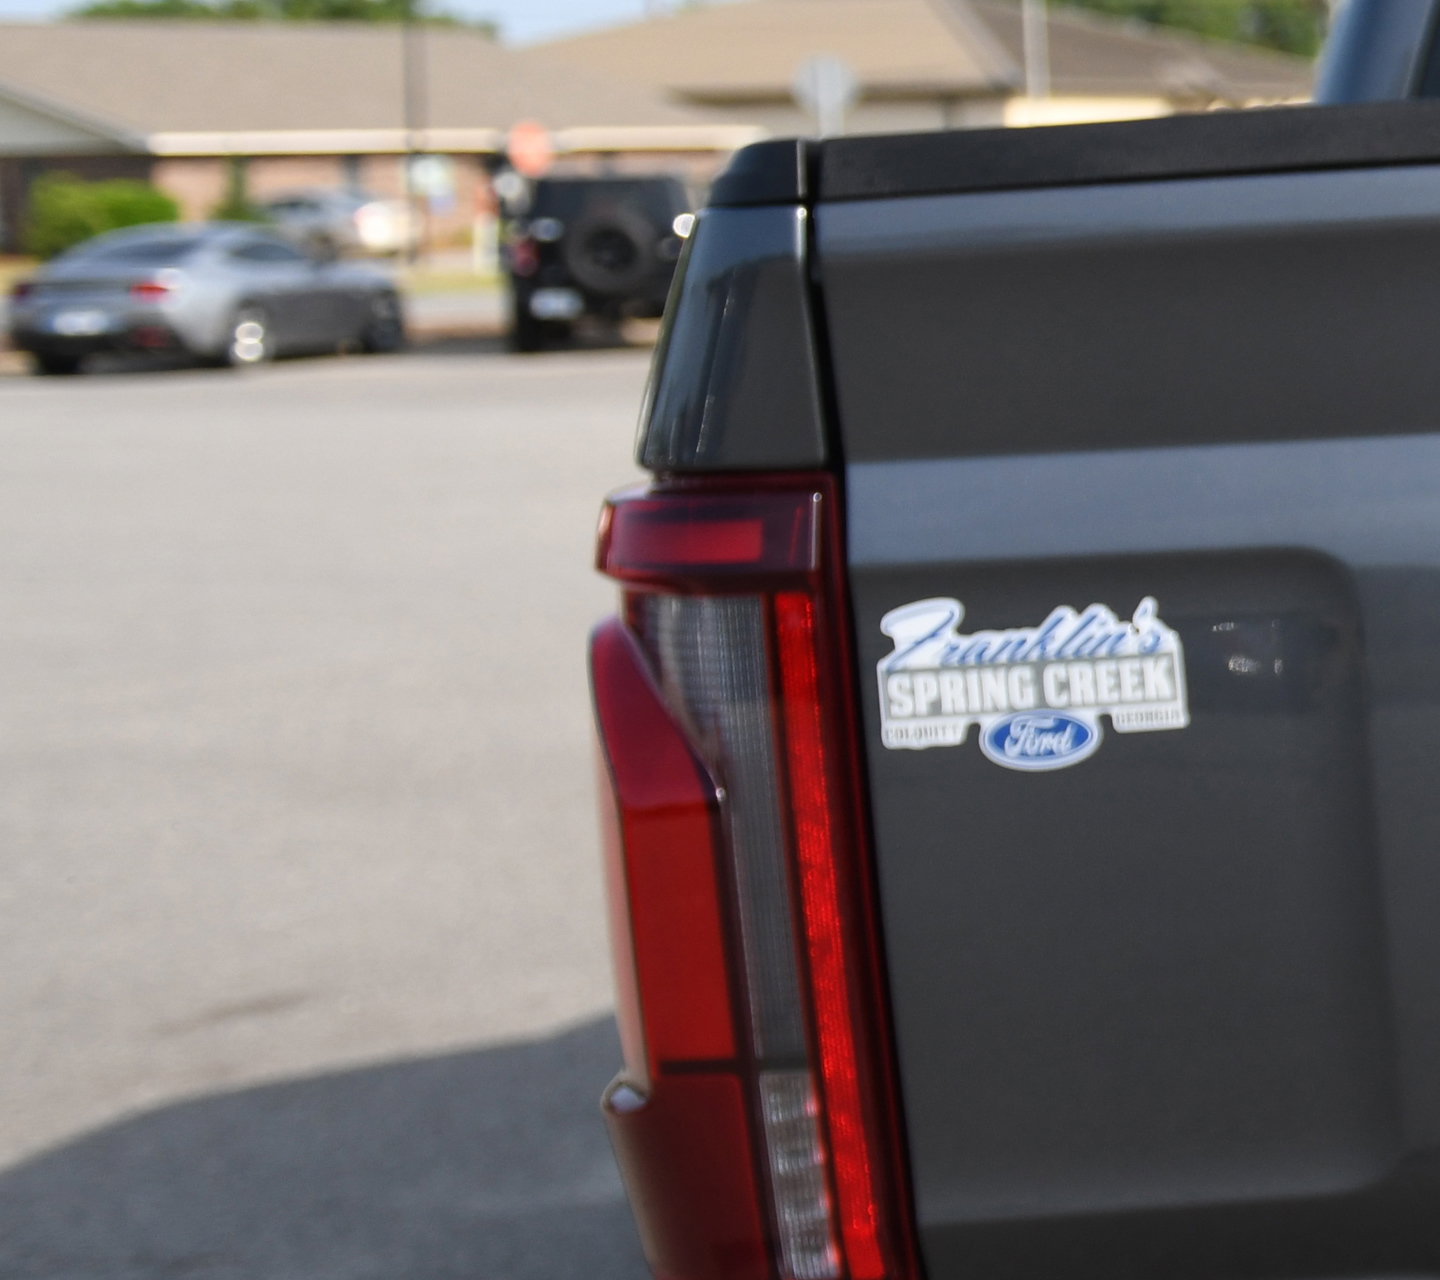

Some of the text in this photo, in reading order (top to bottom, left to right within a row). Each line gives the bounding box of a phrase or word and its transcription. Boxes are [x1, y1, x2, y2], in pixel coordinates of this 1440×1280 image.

[885, 600, 1166, 671] Franklin's
[887, 654, 1175, 718] SPRING CREEK
[1004, 717, 1078, 758] Ford
